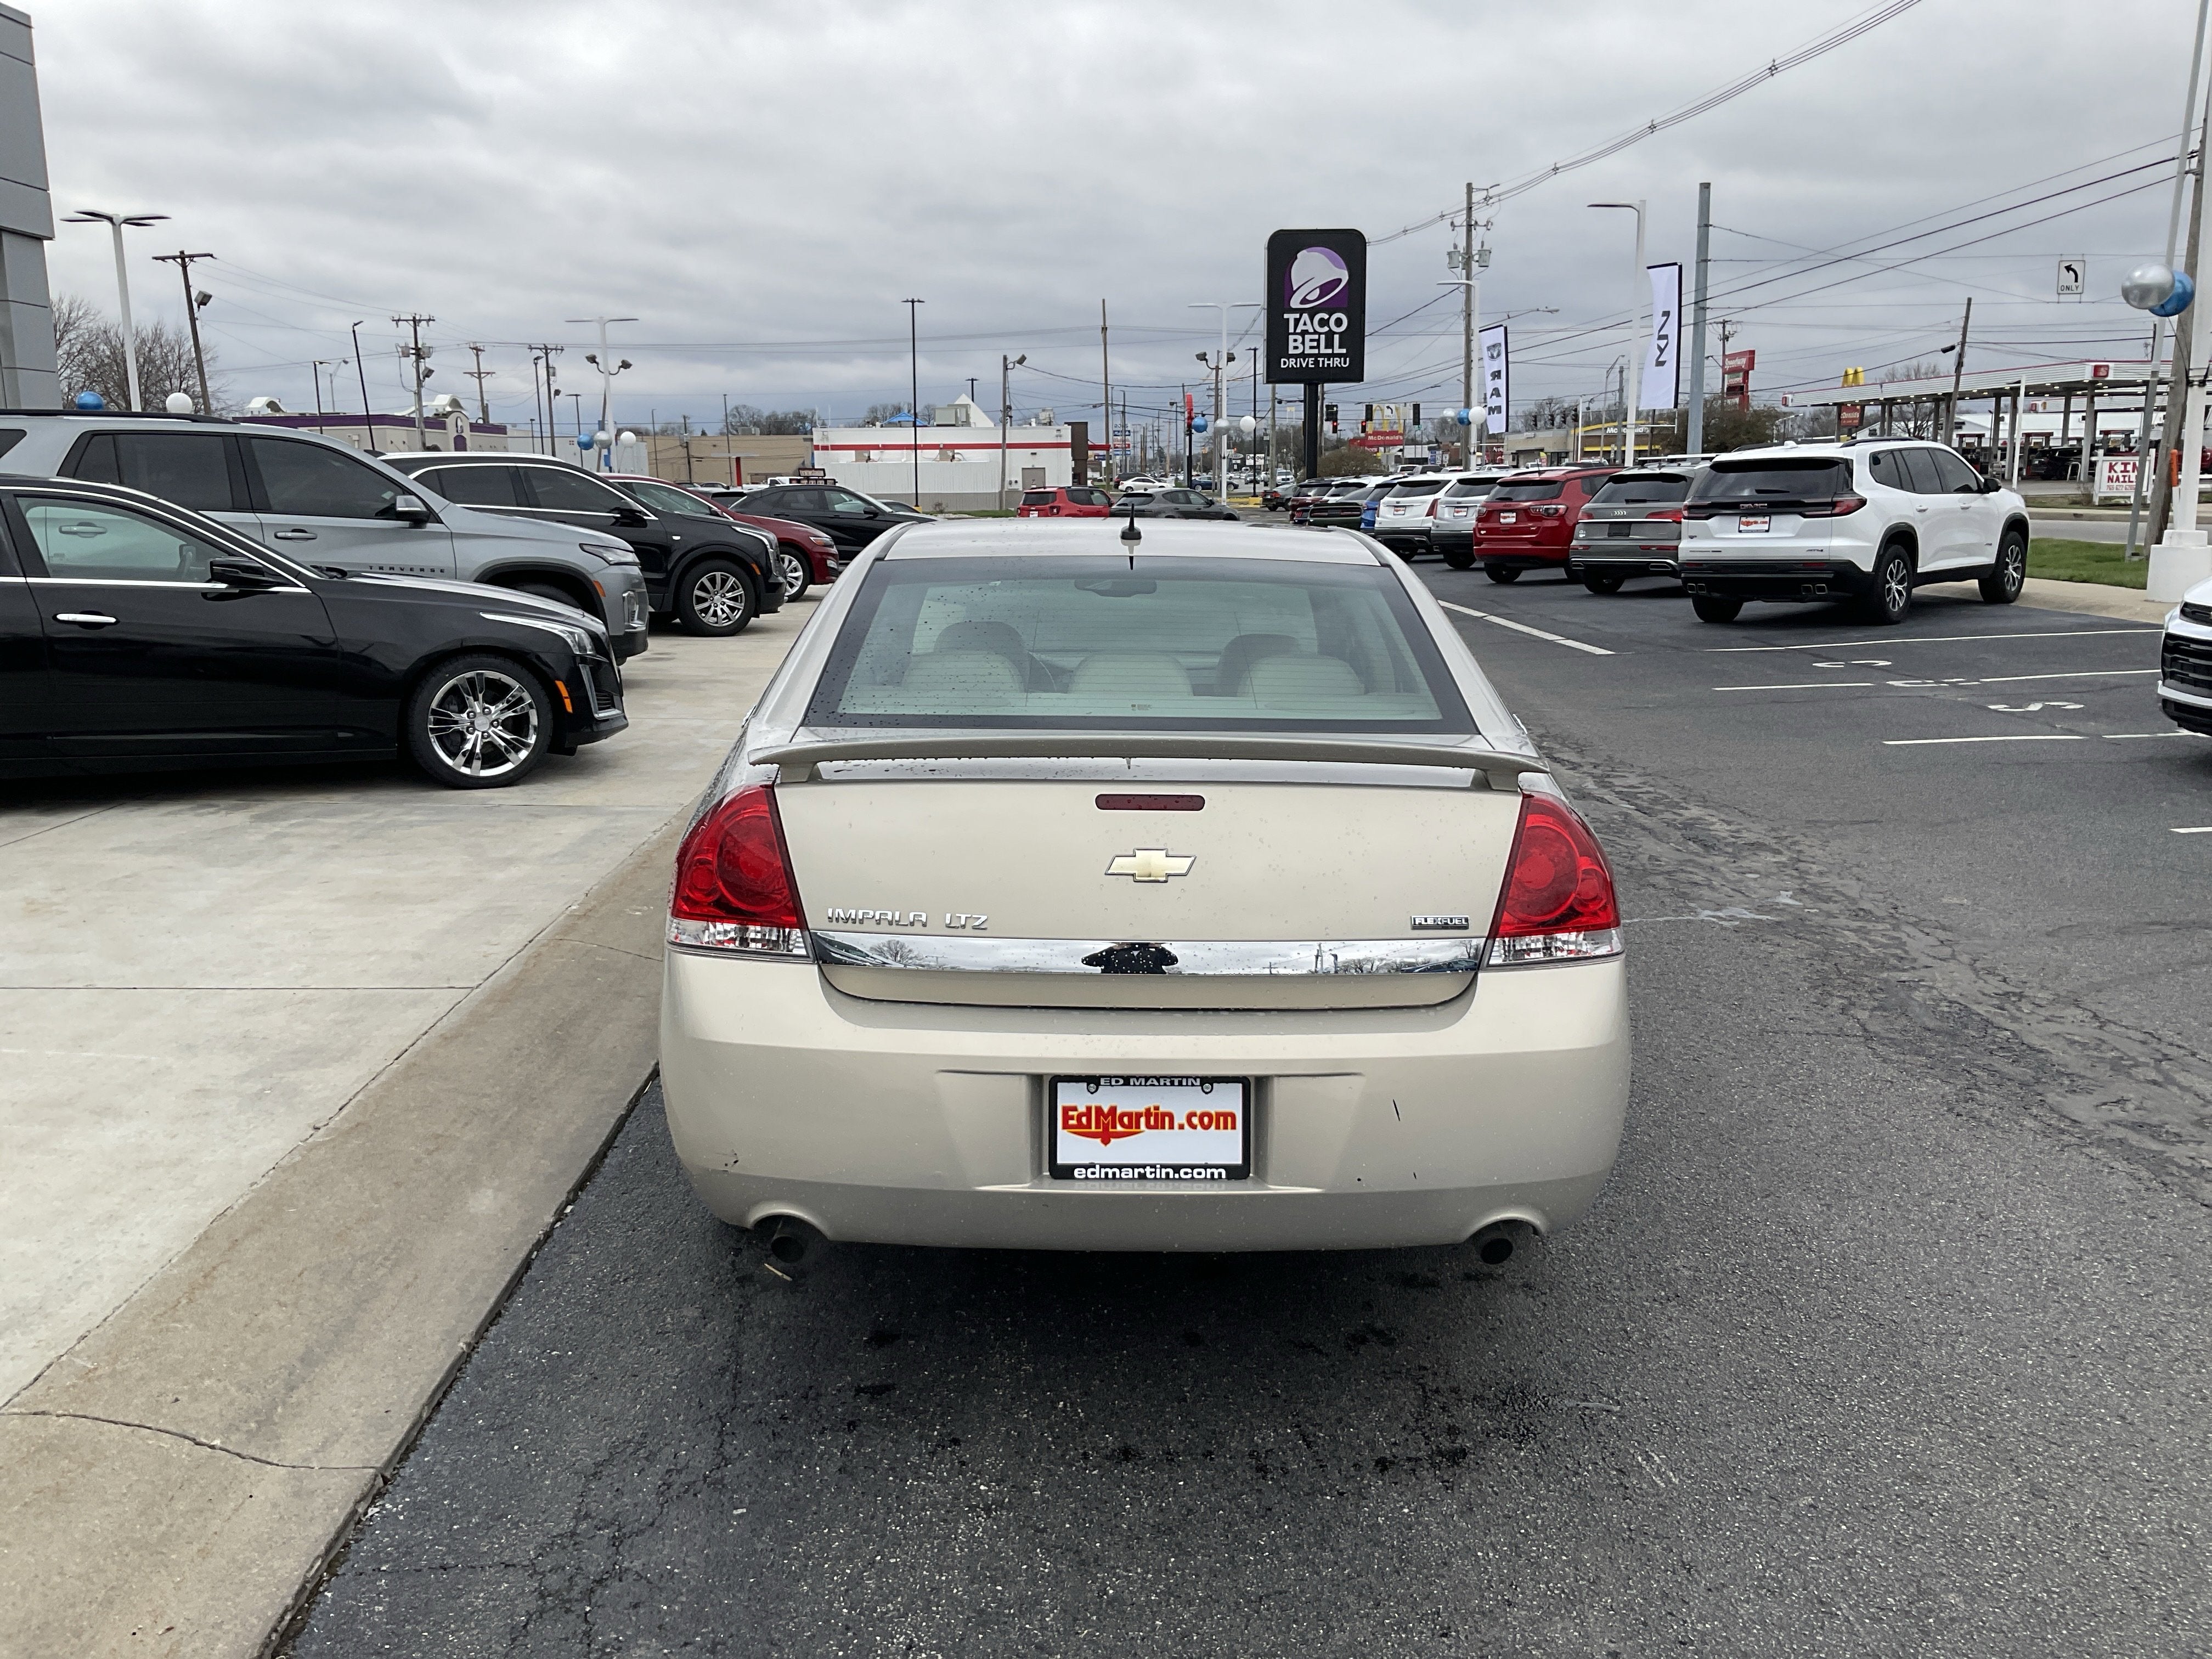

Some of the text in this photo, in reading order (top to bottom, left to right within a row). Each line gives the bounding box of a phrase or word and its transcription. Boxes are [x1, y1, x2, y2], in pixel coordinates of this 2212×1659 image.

[1284, 313, 1347, 332] TACO
[1288, 334, 1346, 354] BELL
[1280, 357, 1349, 368] DRIVE THRU
[827, 908, 988, 930] IMPALA LTZ
[1100, 1077, 1200, 1086] ED MARTIN
[1062, 1104, 1237, 1131] EdMartin.com
[1074, 1165, 1226, 1180] edmartin.com
